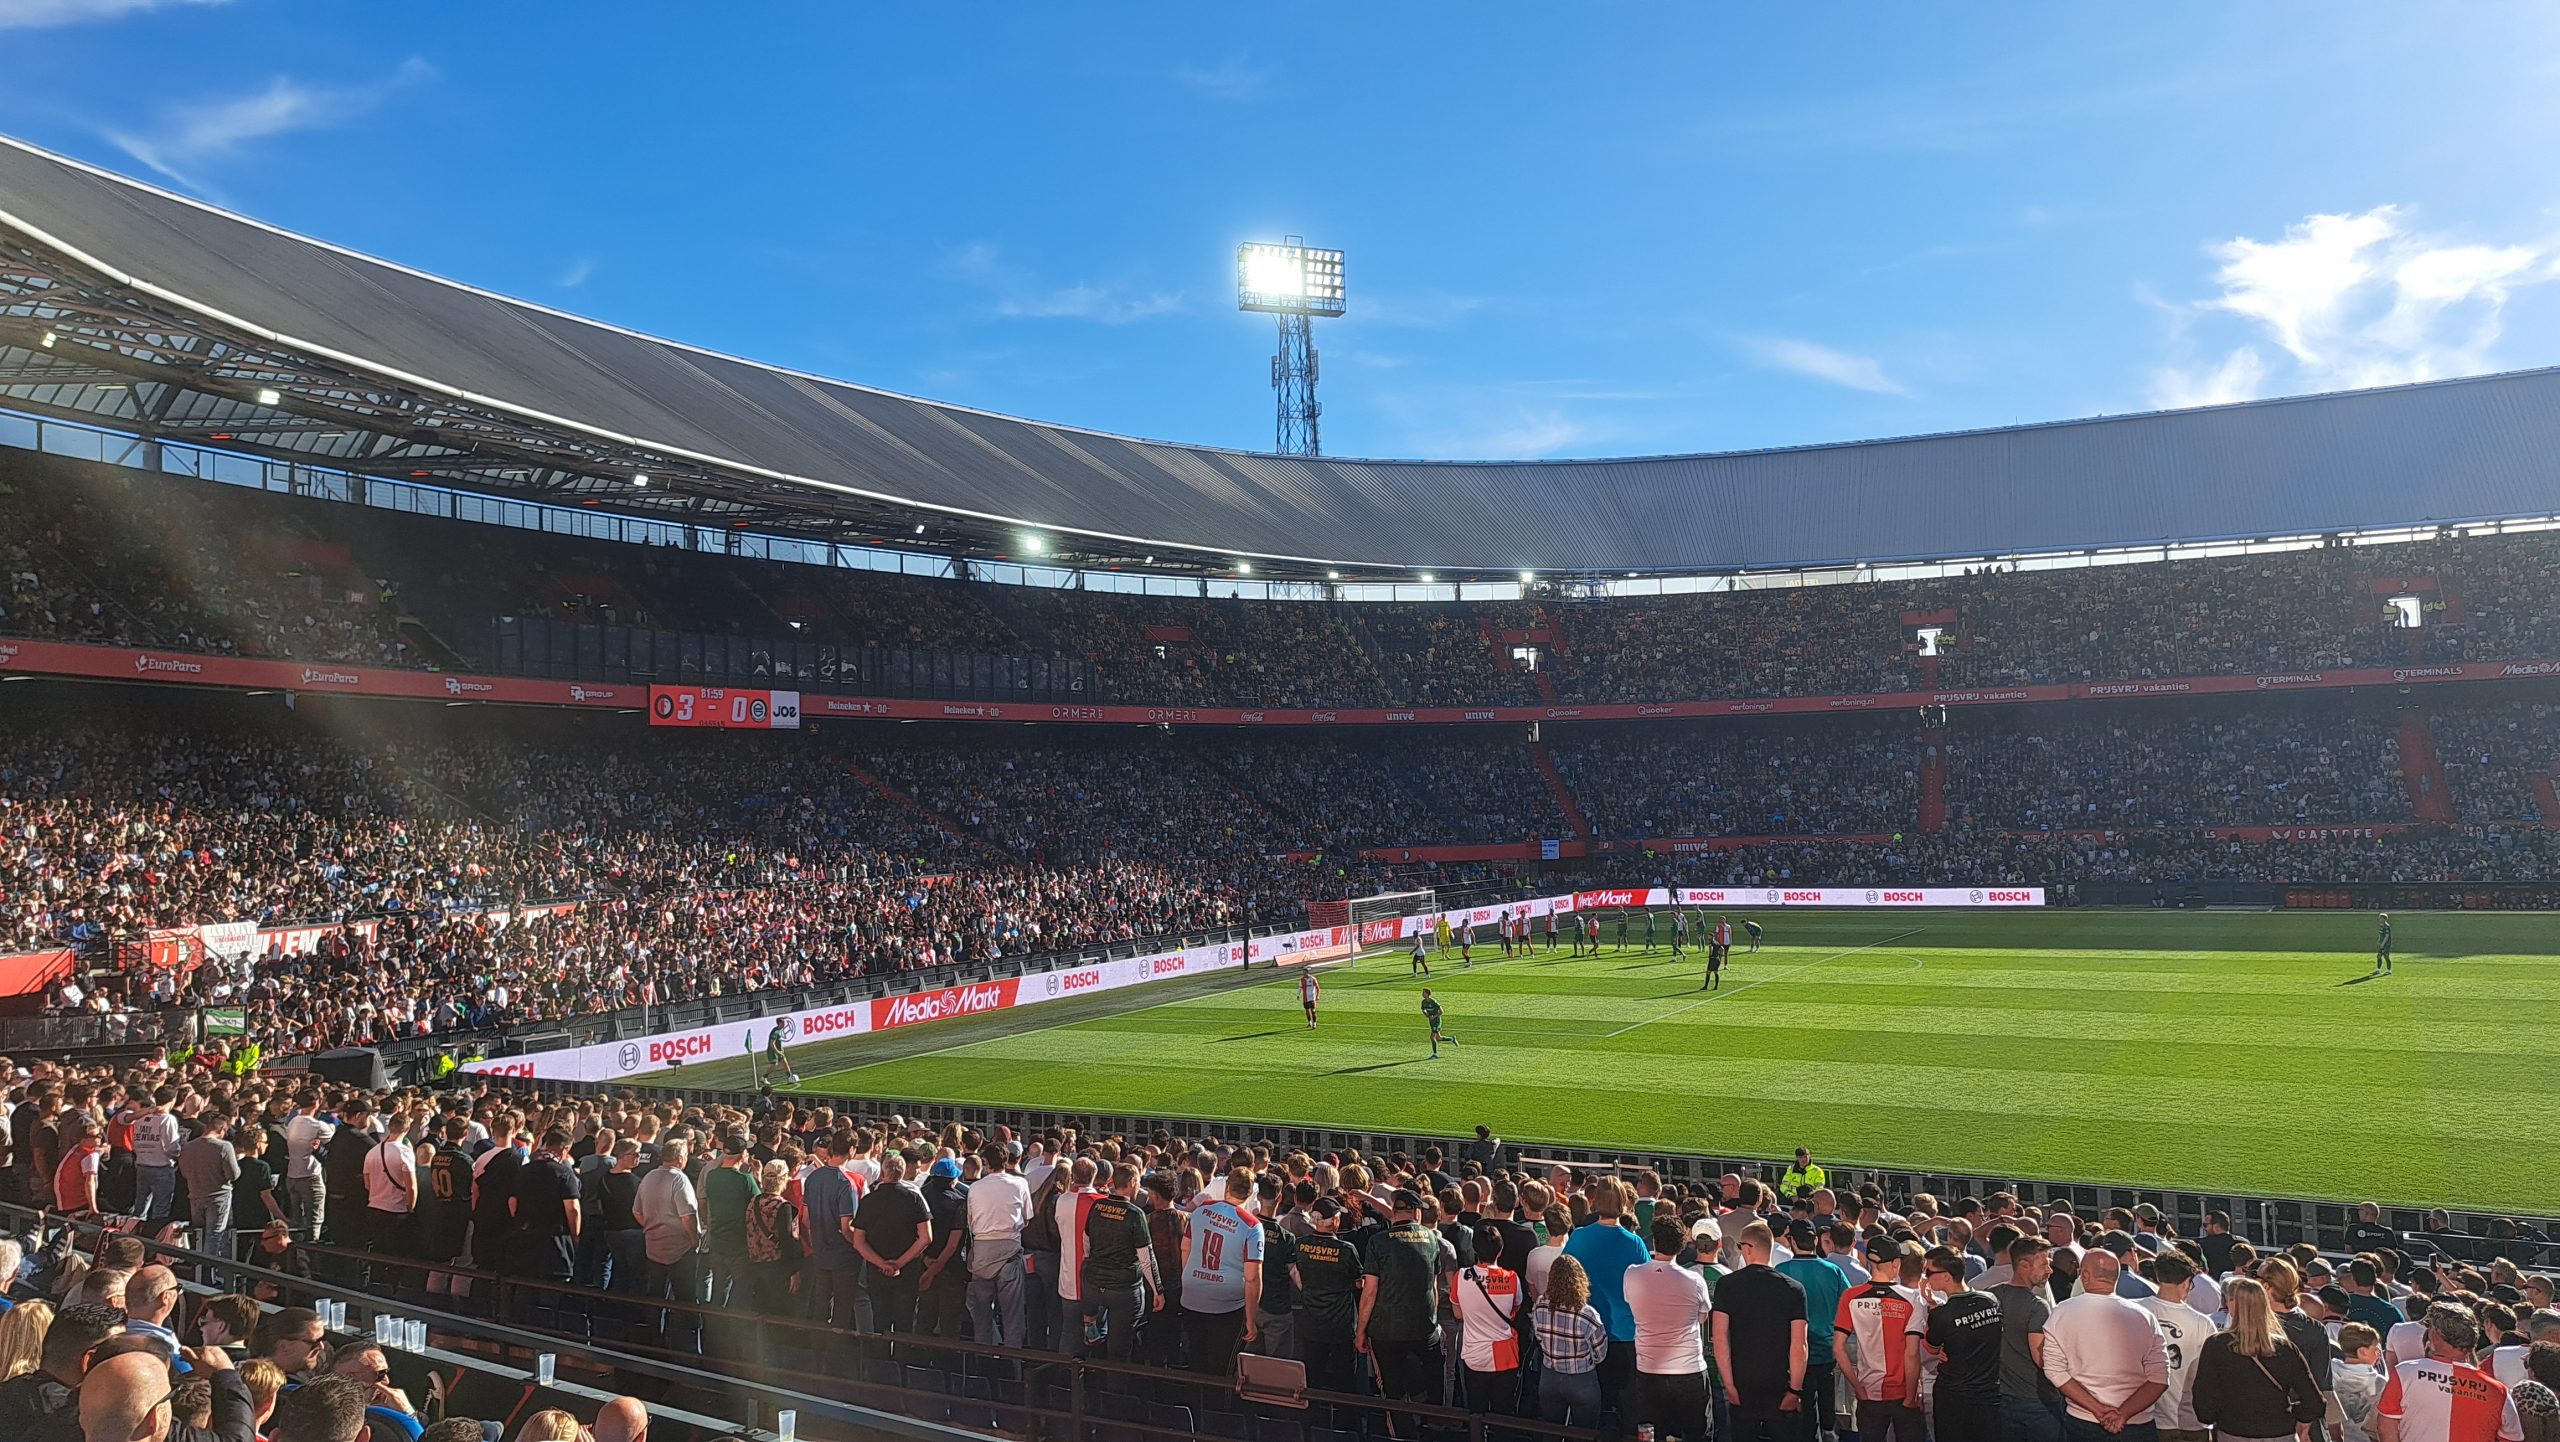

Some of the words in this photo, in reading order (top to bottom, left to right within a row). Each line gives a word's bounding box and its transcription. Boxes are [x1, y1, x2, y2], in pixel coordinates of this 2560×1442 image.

[148, 658, 202, 673] EuroParcs
[2500, 664, 2538, 676] Media
[312, 671, 359, 684] EuroParcs
[2393, 666, 2463, 682] QTERMINALS
[462, 682, 492, 692] GROUP
[2143, 682, 2190, 692] vakanties
[2257, 674, 2322, 688] QTERMINALS
[586, 690, 614, 699] GROUP
[701, 688, 724, 699] 81:59
[1983, 691, 2028, 700] vakanties
[677, 694, 694, 720] 3
[732, 696, 748, 722] 0
[828, 701, 862, 712] Heineken
[944, 706, 976, 715] Heineken
[1547, 708, 1581, 717] Quooker
[1637, 705, 1673, 715] Quooker
[1052, 707, 1096, 719] ORMER
[1148, 709, 1190, 721] ORMER
[1386, 710, 1415, 721] univé
[1465, 709, 1495, 720] univé
[1673, 840, 1708, 852] univé
[1597, 890, 1633, 905] Markt
[1689, 892, 1724, 901] BOSCH
[1783, 892, 1821, 901] BOSCH
[1883, 892, 1923, 901] BOSCH
[1989, 892, 2030, 901] BOSCH
[1555, 899, 1569, 909] BOSCH
[1473, 910, 1491, 922] BOSCH
[1300, 934, 1324, 949] BOSCH
[1231, 944, 1259, 961] BOCH
[1154, 956, 1185, 974] BOSCH
[1064, 971, 1099, 990] BOSCH
[884, 997, 941, 1027] Media
[954, 985, 1001, 1014] Markt
[803, 1011, 855, 1035] BOSCH
[650, 1034, 711, 1062] BOSCH
[1201, 1229, 1224, 1271] 19
[1192, 1269, 1225, 1283] STERLING
[2437, 1384, 2488, 1402] vakanties
